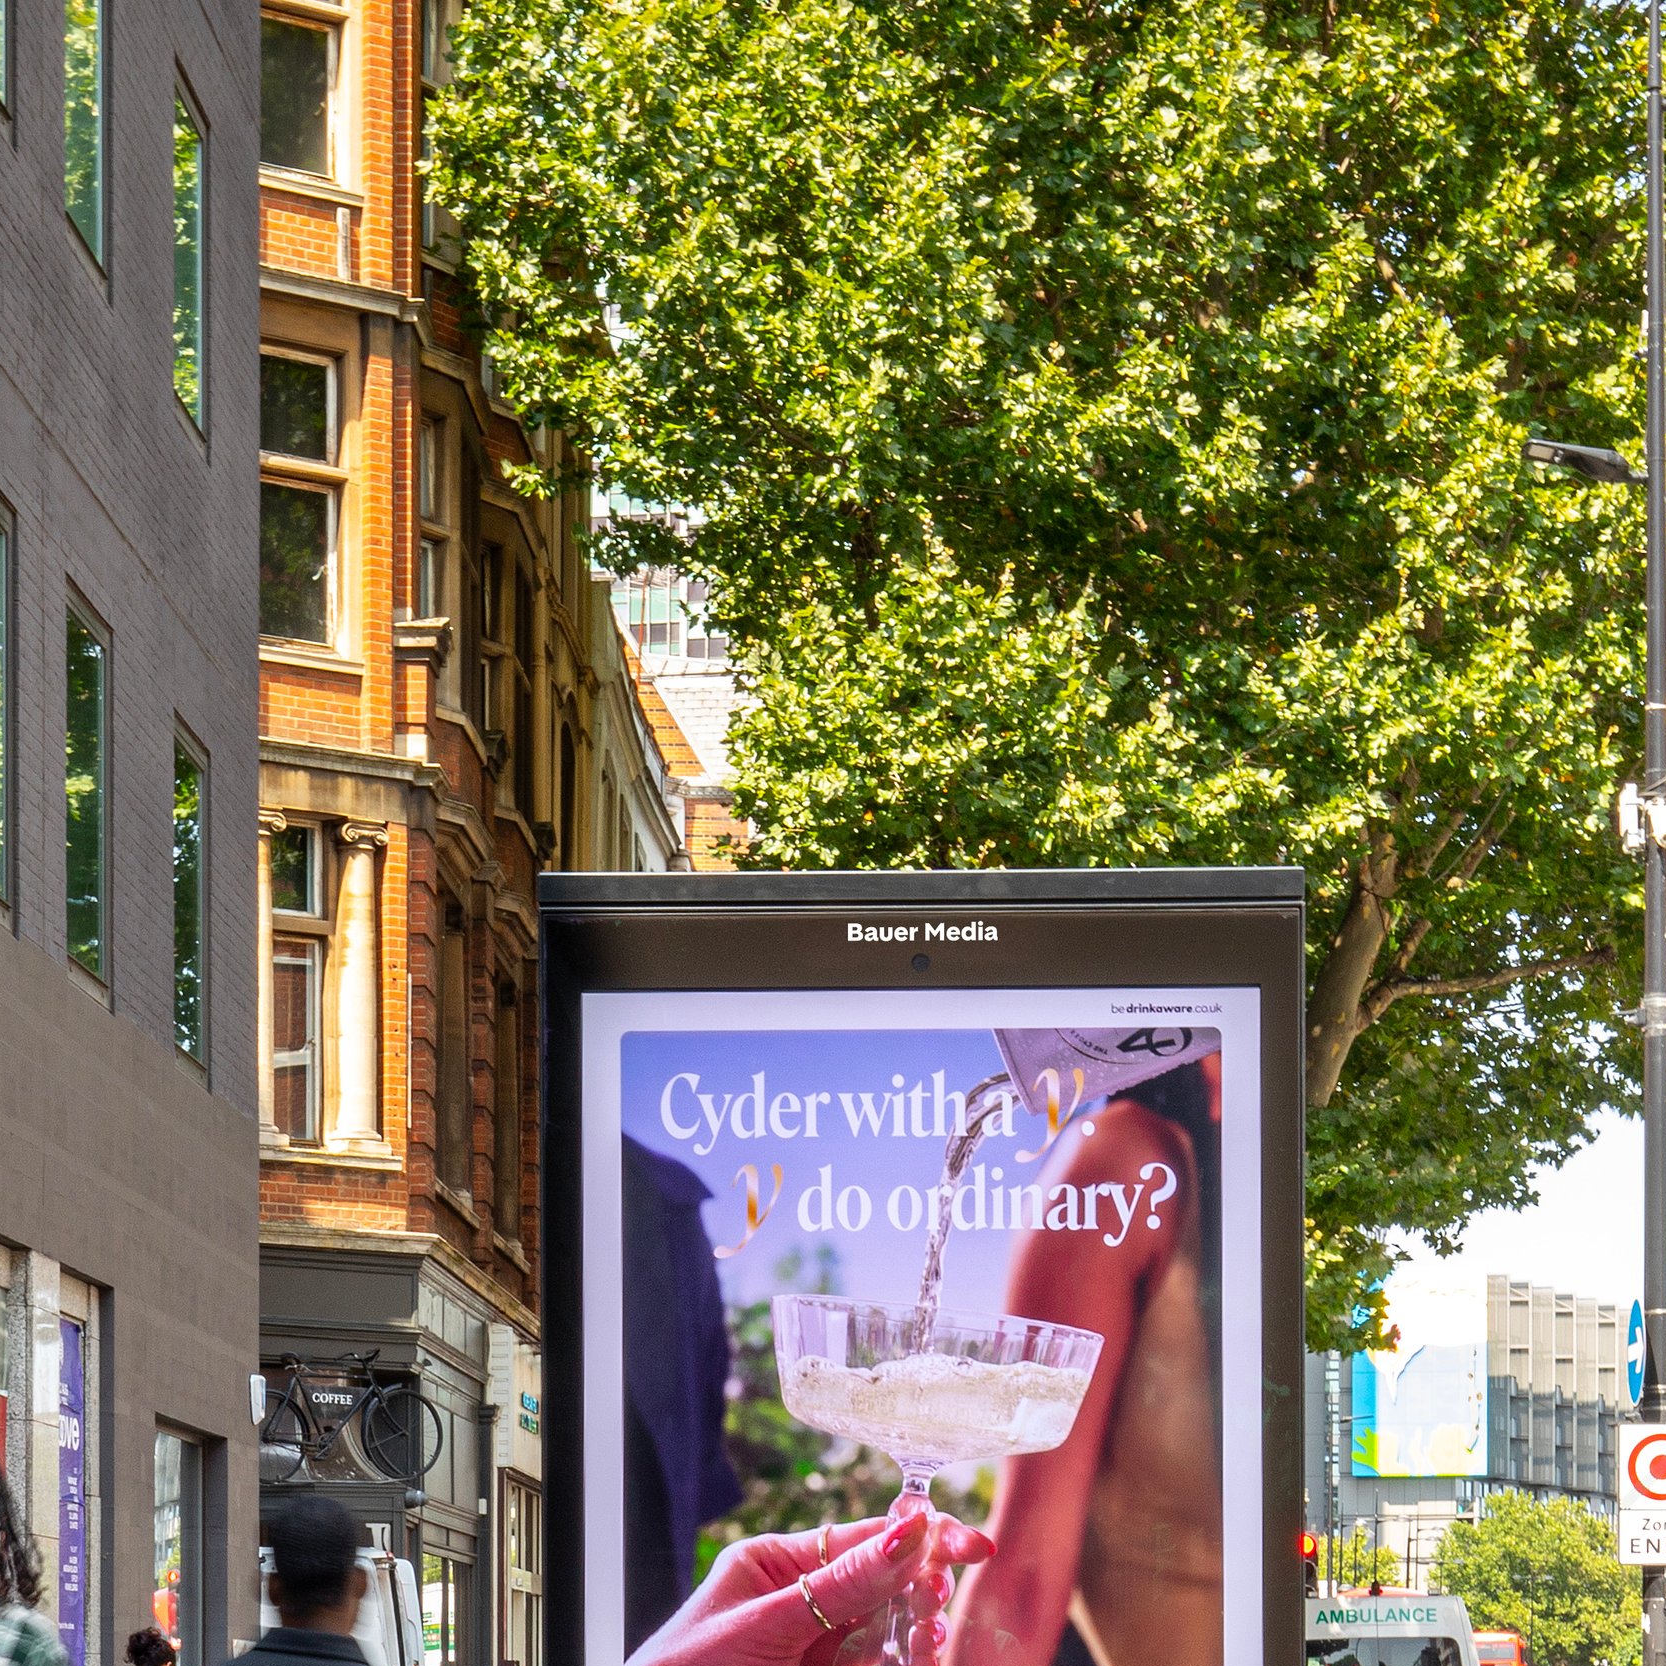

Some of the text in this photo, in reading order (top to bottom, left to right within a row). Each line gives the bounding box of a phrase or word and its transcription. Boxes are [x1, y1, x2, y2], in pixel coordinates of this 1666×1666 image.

[847, 921, 998, 942] Bauer Media
[661, 1070, 829, 1155] Cyder
[844, 1069, 966, 1138] with
[983, 1088, 1018, 1138] a
[798, 1164, 872, 1233] do
[887, 1162, 1177, 1248] ordinary?
[312, 1391, 354, 1406] COFFEE
[1315, 1607, 1438, 1625] AMBULANCE
